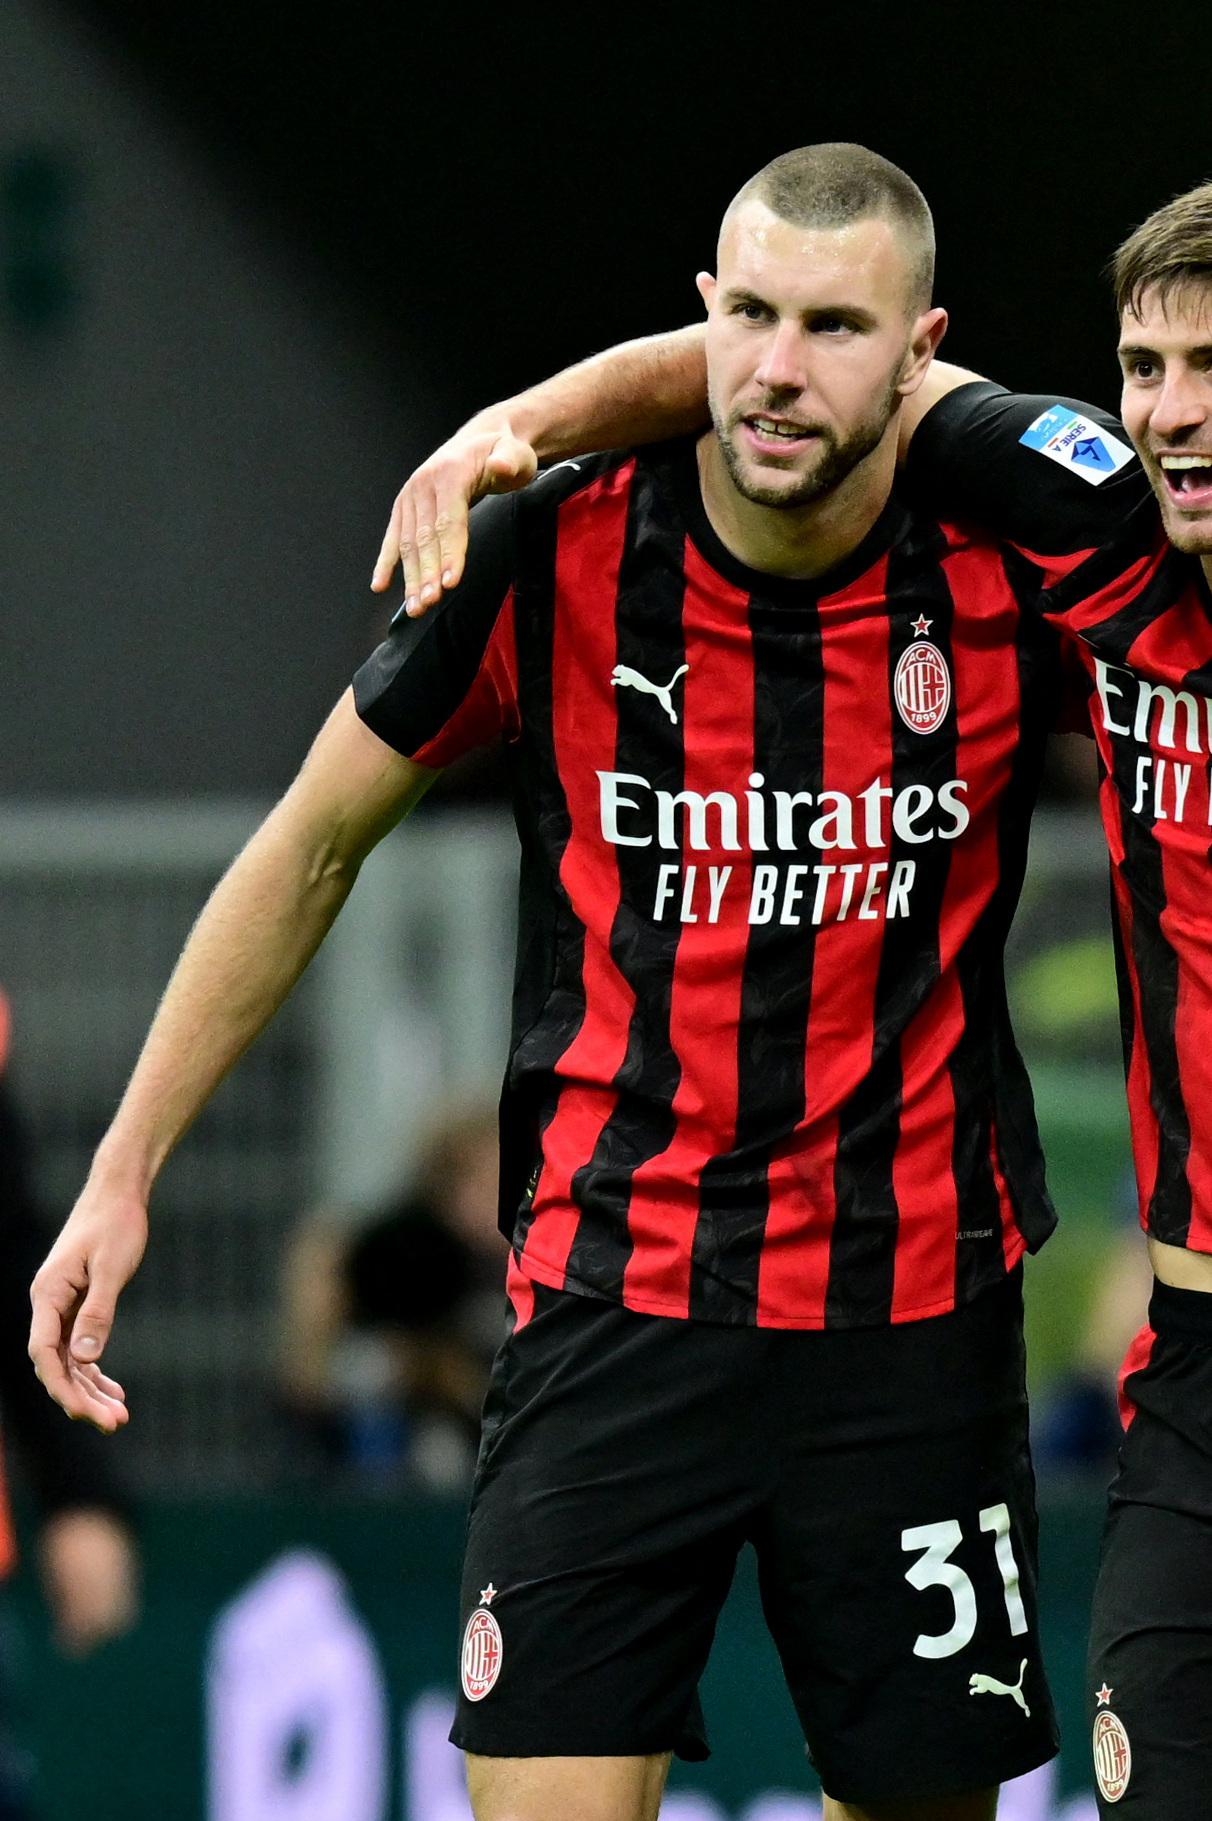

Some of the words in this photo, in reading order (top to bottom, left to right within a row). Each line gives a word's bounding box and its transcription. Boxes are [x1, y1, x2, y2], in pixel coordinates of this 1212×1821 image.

[1060, 423, 1087, 447] SERIE
[1052, 444, 1062, 452] A
[906, 648, 937, 668] ACM
[911, 712, 938, 724] 1899
[1131, 756, 1192, 824] FLY
[595, 770, 971, 851] Emirates
[652, 864, 733, 922] FLY
[747, 859, 917, 926] BETTER
[901, 1502, 1029, 1660] 31
[469, 1680, 489, 1691] 1899
